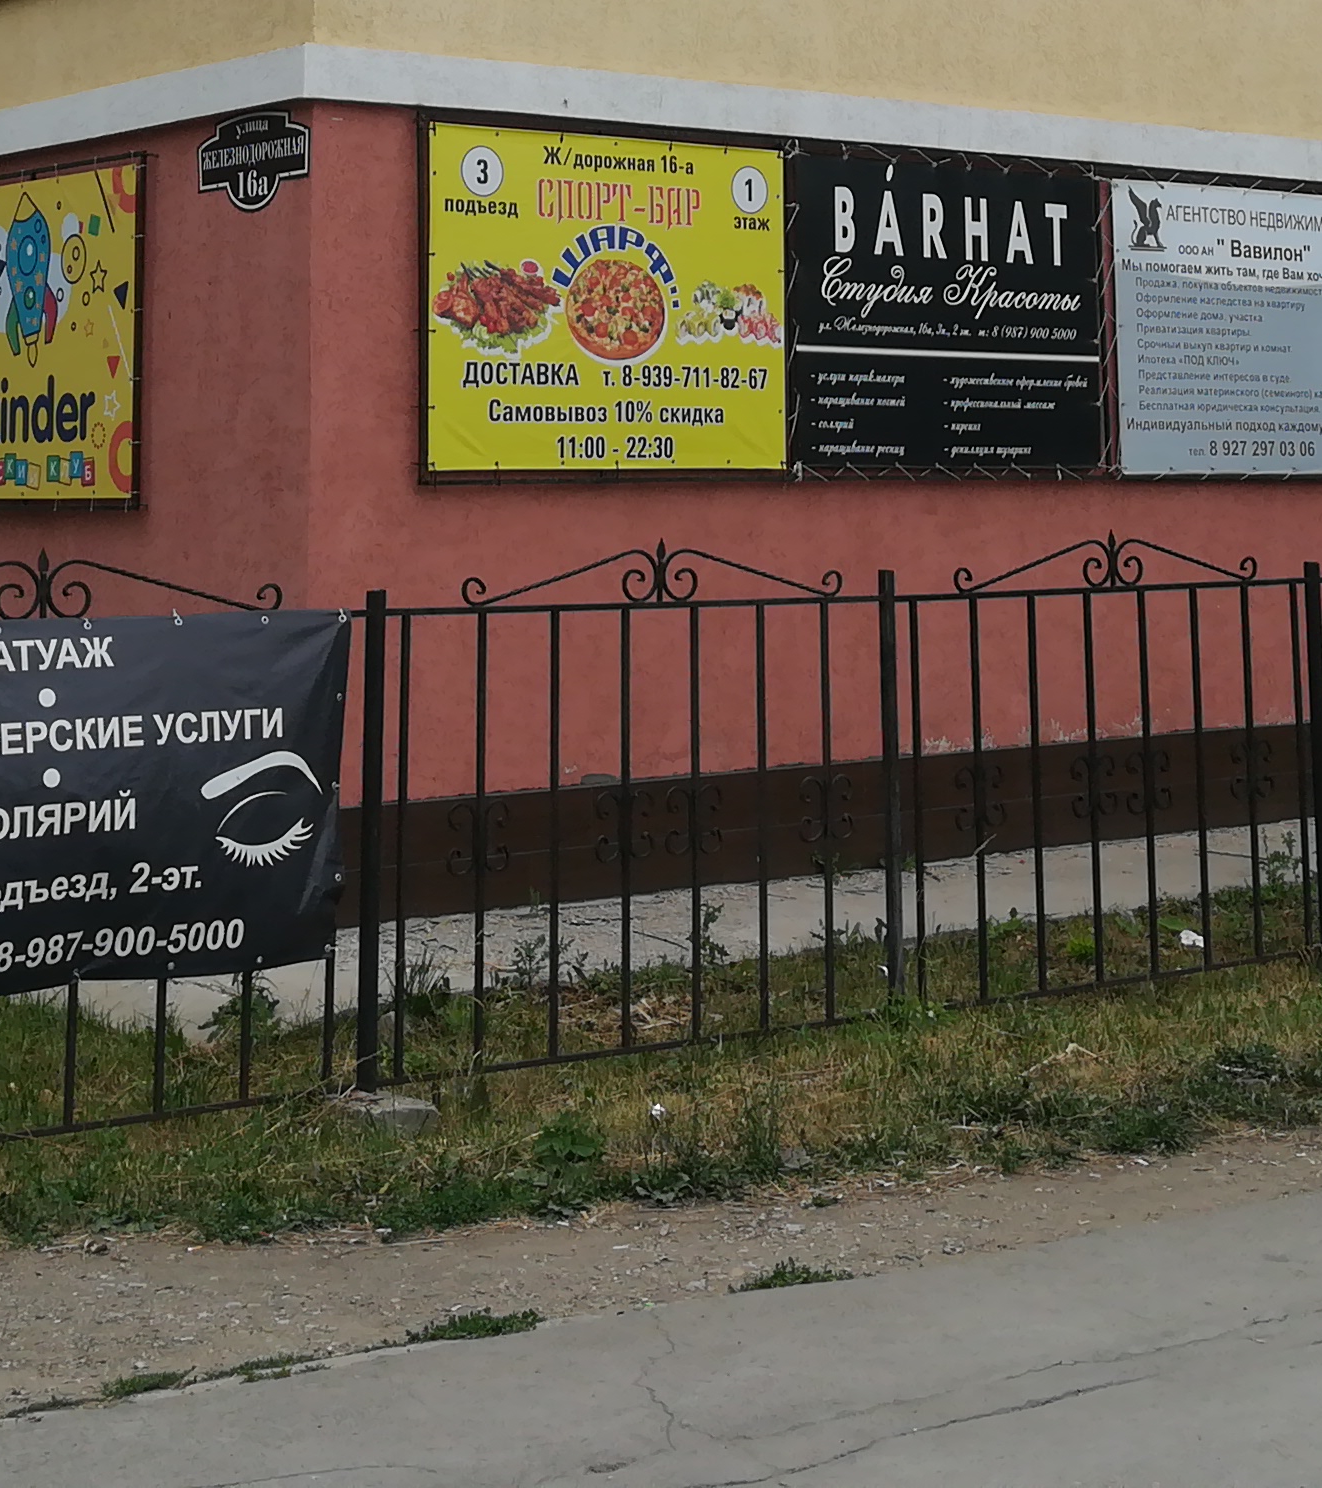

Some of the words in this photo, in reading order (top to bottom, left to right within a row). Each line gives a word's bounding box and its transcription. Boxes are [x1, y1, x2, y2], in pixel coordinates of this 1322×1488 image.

[203, 135, 305, 171] ЖЕЛЕЗНОДОРОЖНАЯ
[543, 145, 655, 174] Ж/дорожная
[660, 155, 694, 176] 16-а
[237, 169, 269, 199] 16а
[476, 159, 489, 185] 3
[745, 179, 755, 203] 1
[444, 197, 519, 219] подъезд
[536, 178, 702, 231] СПОРТ-БАР
[1166, 204, 1246, 226] АГЕНТСТВО
[733, 215, 770, 231] этаж
[1122, 259, 1142, 272] Мы
[1145, 262, 1202, 274] помогаем
[1205, 265, 1233, 277] жить
[1262, 269, 1279, 280] где
[1282, 267, 1304, 280] Вам
[821, 256, 933, 318] Студия
[943, 264, 1081, 320] Красоты
[1001, 324, 1028, 339] (987)
[1030, 327, 1050, 340] 900
[1051, 327, 1077, 340] 5000
[462, 363, 580, 388] ДОСТАВКА
[622, 365, 768, 390] 8-939-711-82-67
[488, 399, 607, 424] Самовывоз
[615, 400, 652, 424] 10%
[659, 403, 725, 427] скидка
[1127, 418, 1233, 434] Индивидуальный
[1236, 420, 1276, 434] подход
[557, 436, 606, 460] 11:00
[626, 436, 675, 460] 22:30
[1209, 440, 1218, 457] 8
[1222, 440, 1247, 457] 927
[1252, 440, 1275, 457] 297
[1279, 441, 1296, 457] 03
[1299, 441, 1316, 457] 06
[153, 707, 284, 746] УСЛУГИ
[129, 861, 204, 896] 2-эт.
